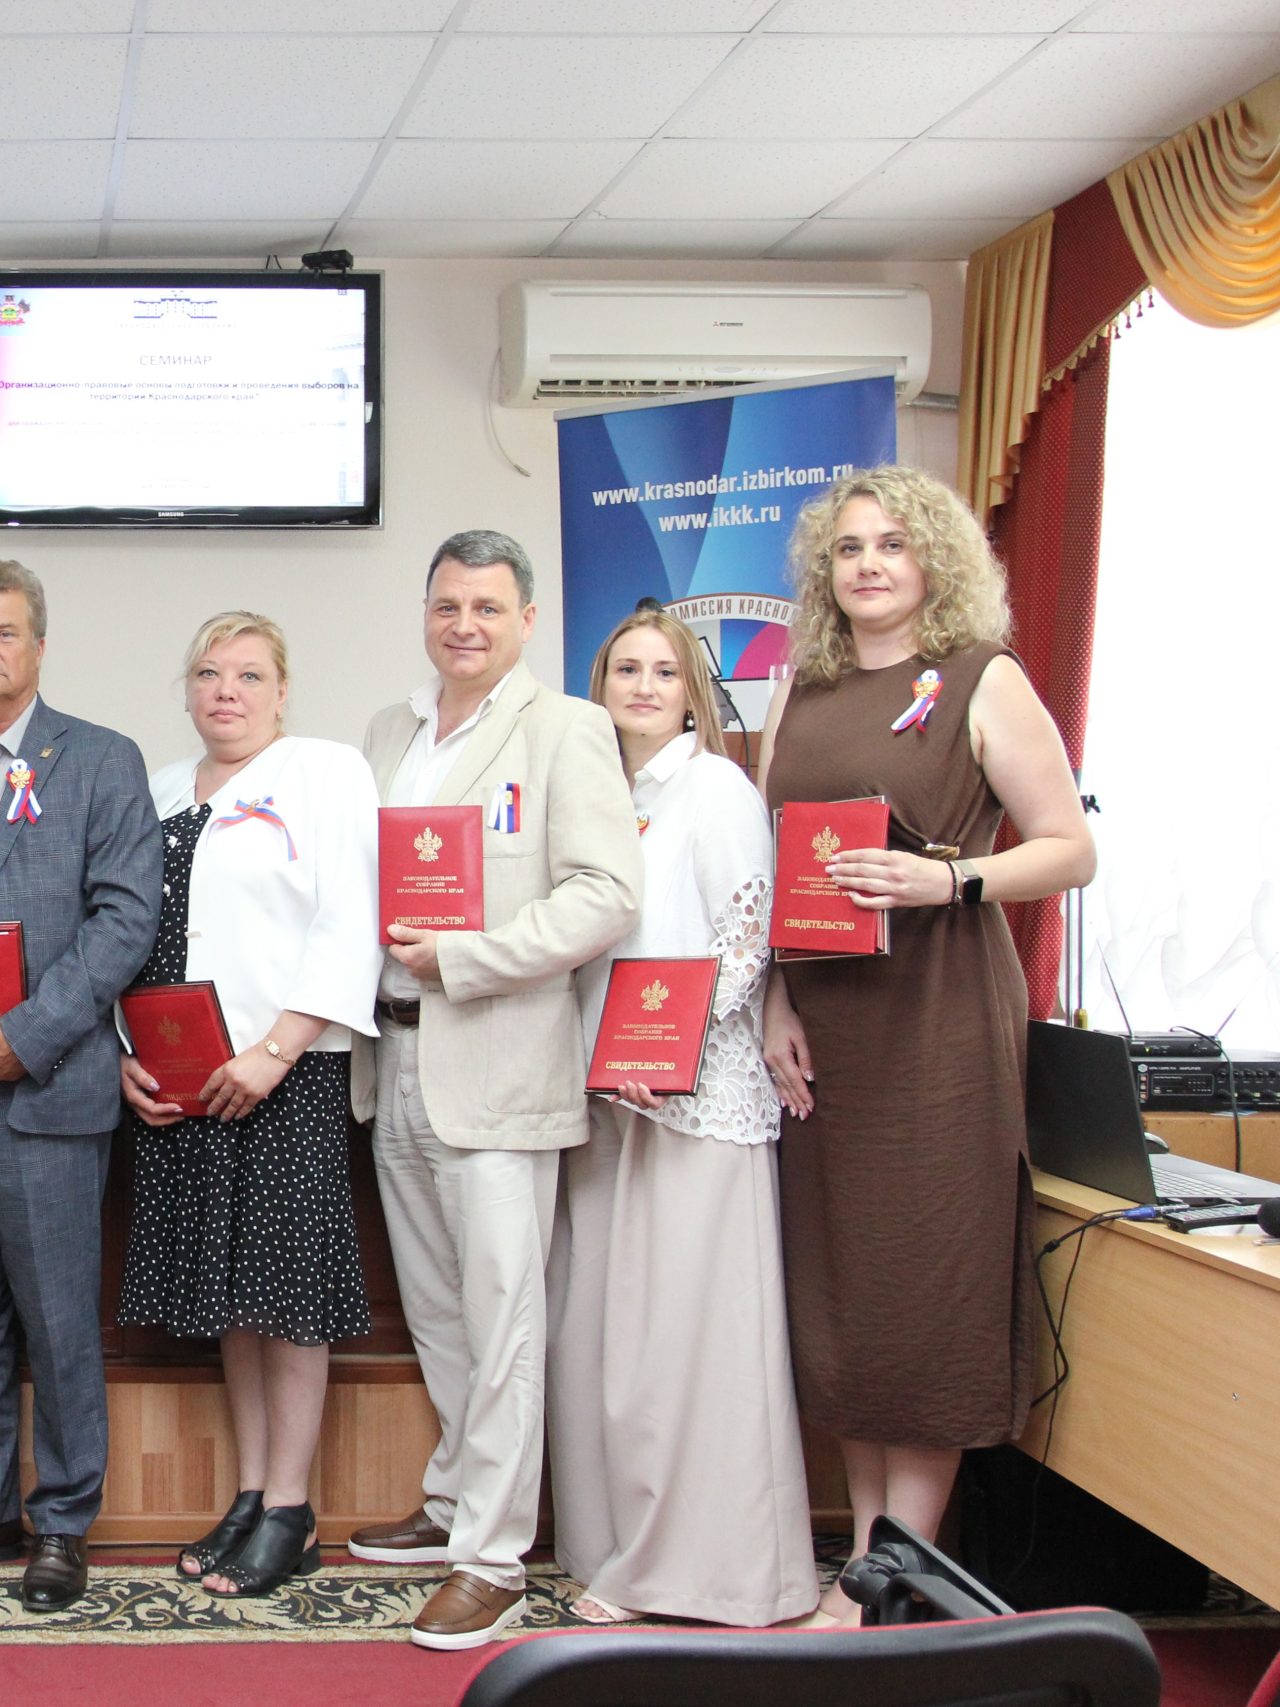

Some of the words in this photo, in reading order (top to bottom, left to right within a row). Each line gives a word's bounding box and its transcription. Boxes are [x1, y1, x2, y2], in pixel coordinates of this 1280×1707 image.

[139, 355, 212, 366] СЕМИНАР
[174, 382, 229, 390] подготовки
[240, 382, 300, 390] проведения
[302, 381, 345, 390] выборов
[90, 393, 146, 401] территории
[149, 393, 229, 401] Краснодарского
[592, 463, 854, 507] www.krasnodar.izbirkom.ru
[658, 505, 781, 533] www.ikkk.ru
[739, 598, 797, 623] КРАСНО
[395, 916, 466, 926] СВИДЕТЕЛЬСТВО
[784, 918, 855, 931] СВИДЕТЕЛЬСТВО
[605, 1060, 675, 1072] СВИДЕТЕЛЬСТВО
